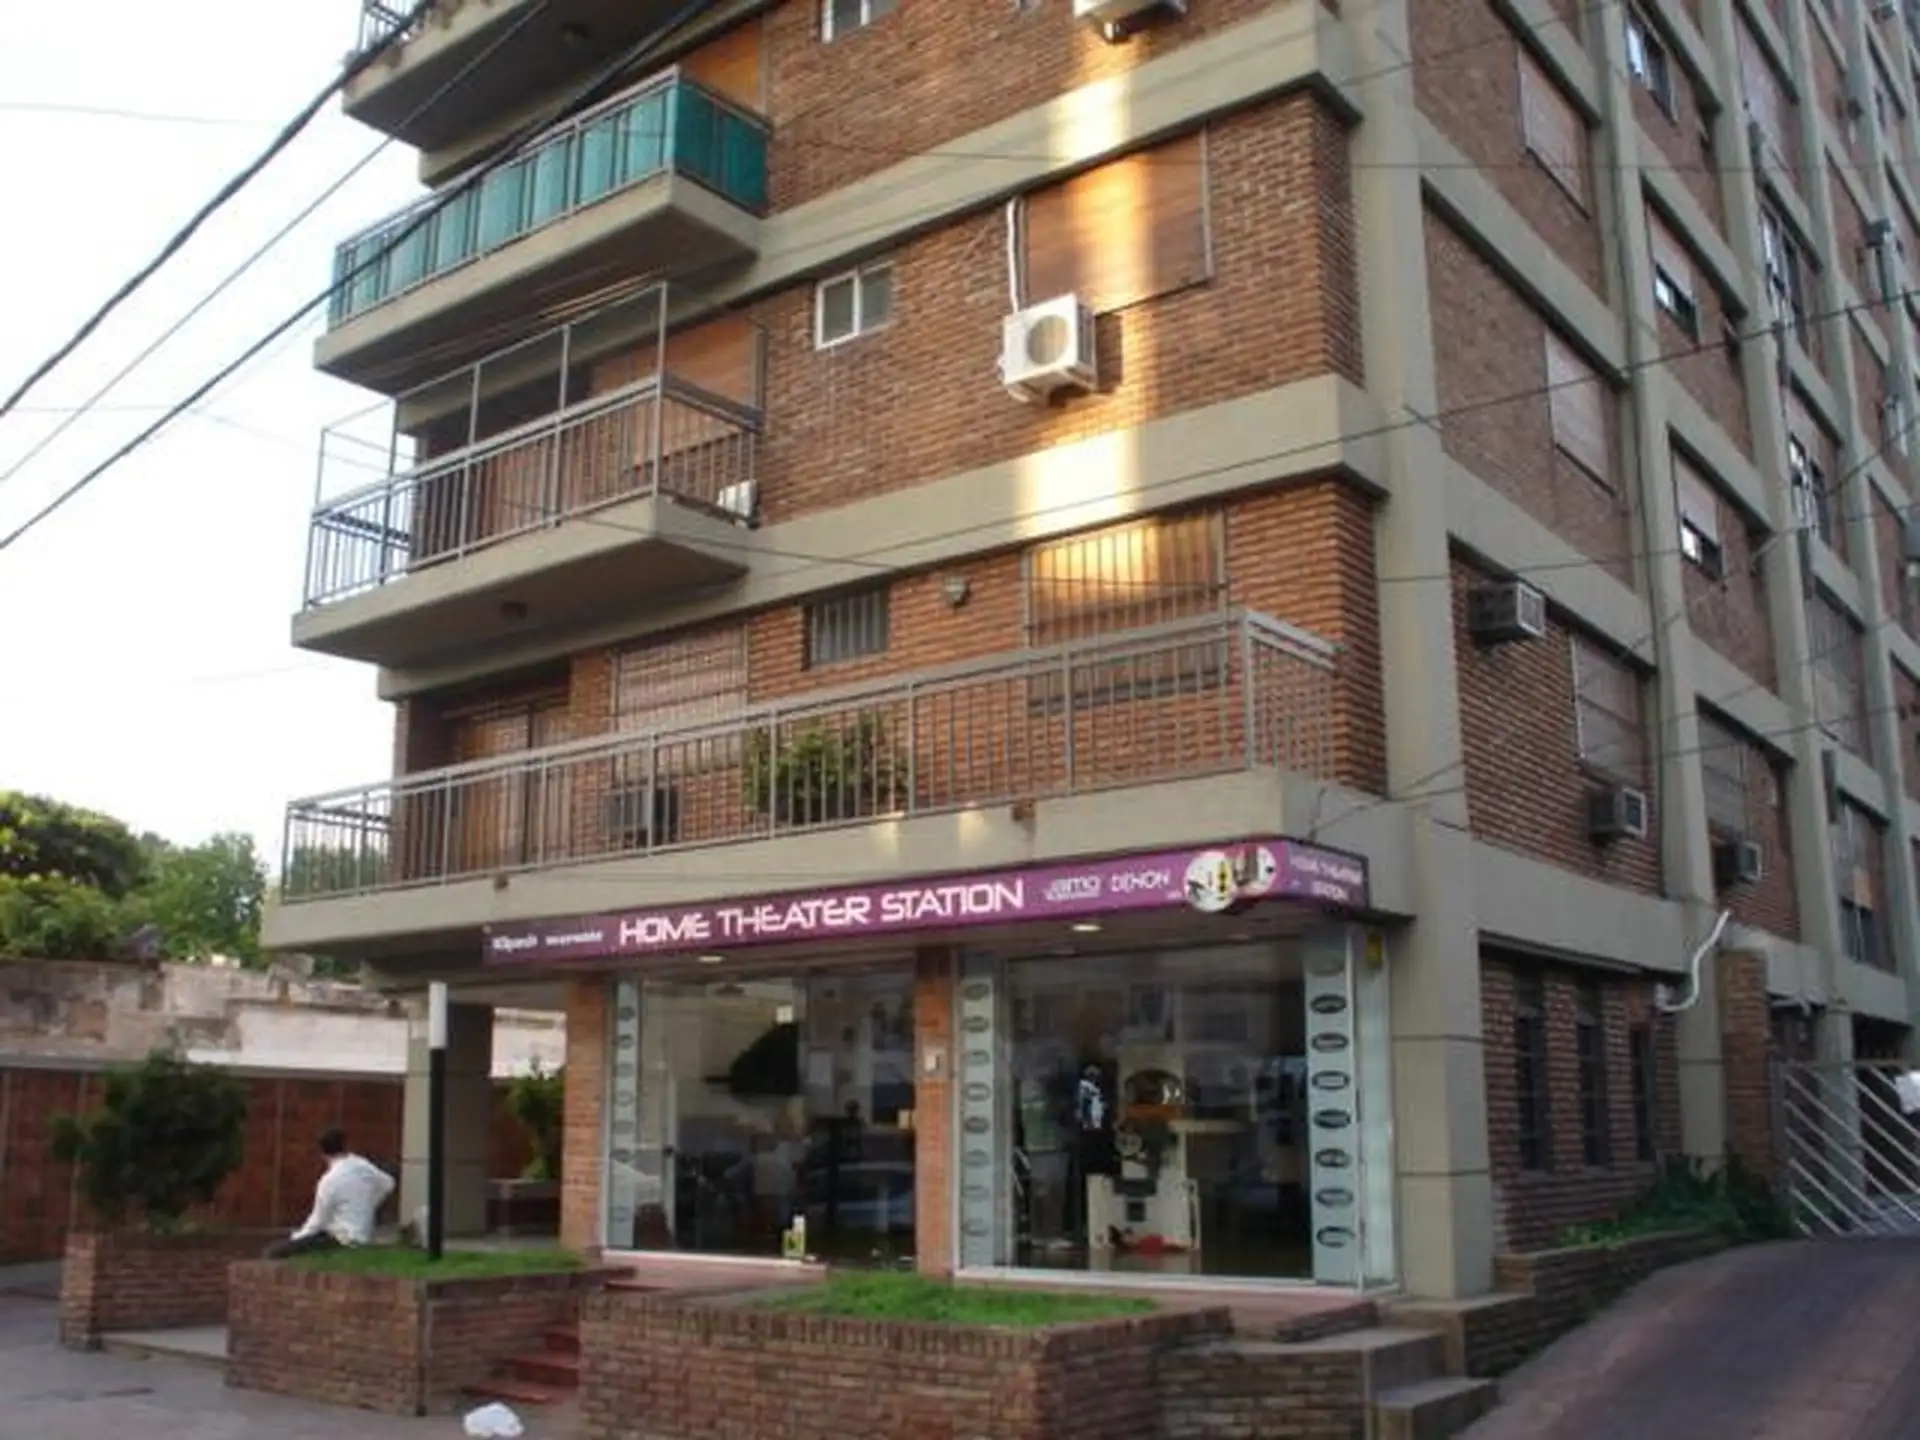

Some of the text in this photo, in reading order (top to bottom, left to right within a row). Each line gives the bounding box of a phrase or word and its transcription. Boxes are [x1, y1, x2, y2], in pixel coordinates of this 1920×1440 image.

[619, 911, 711, 946] HOME
[716, 895, 872, 937] THEATER
[880, 876, 1025, 923] STATION
